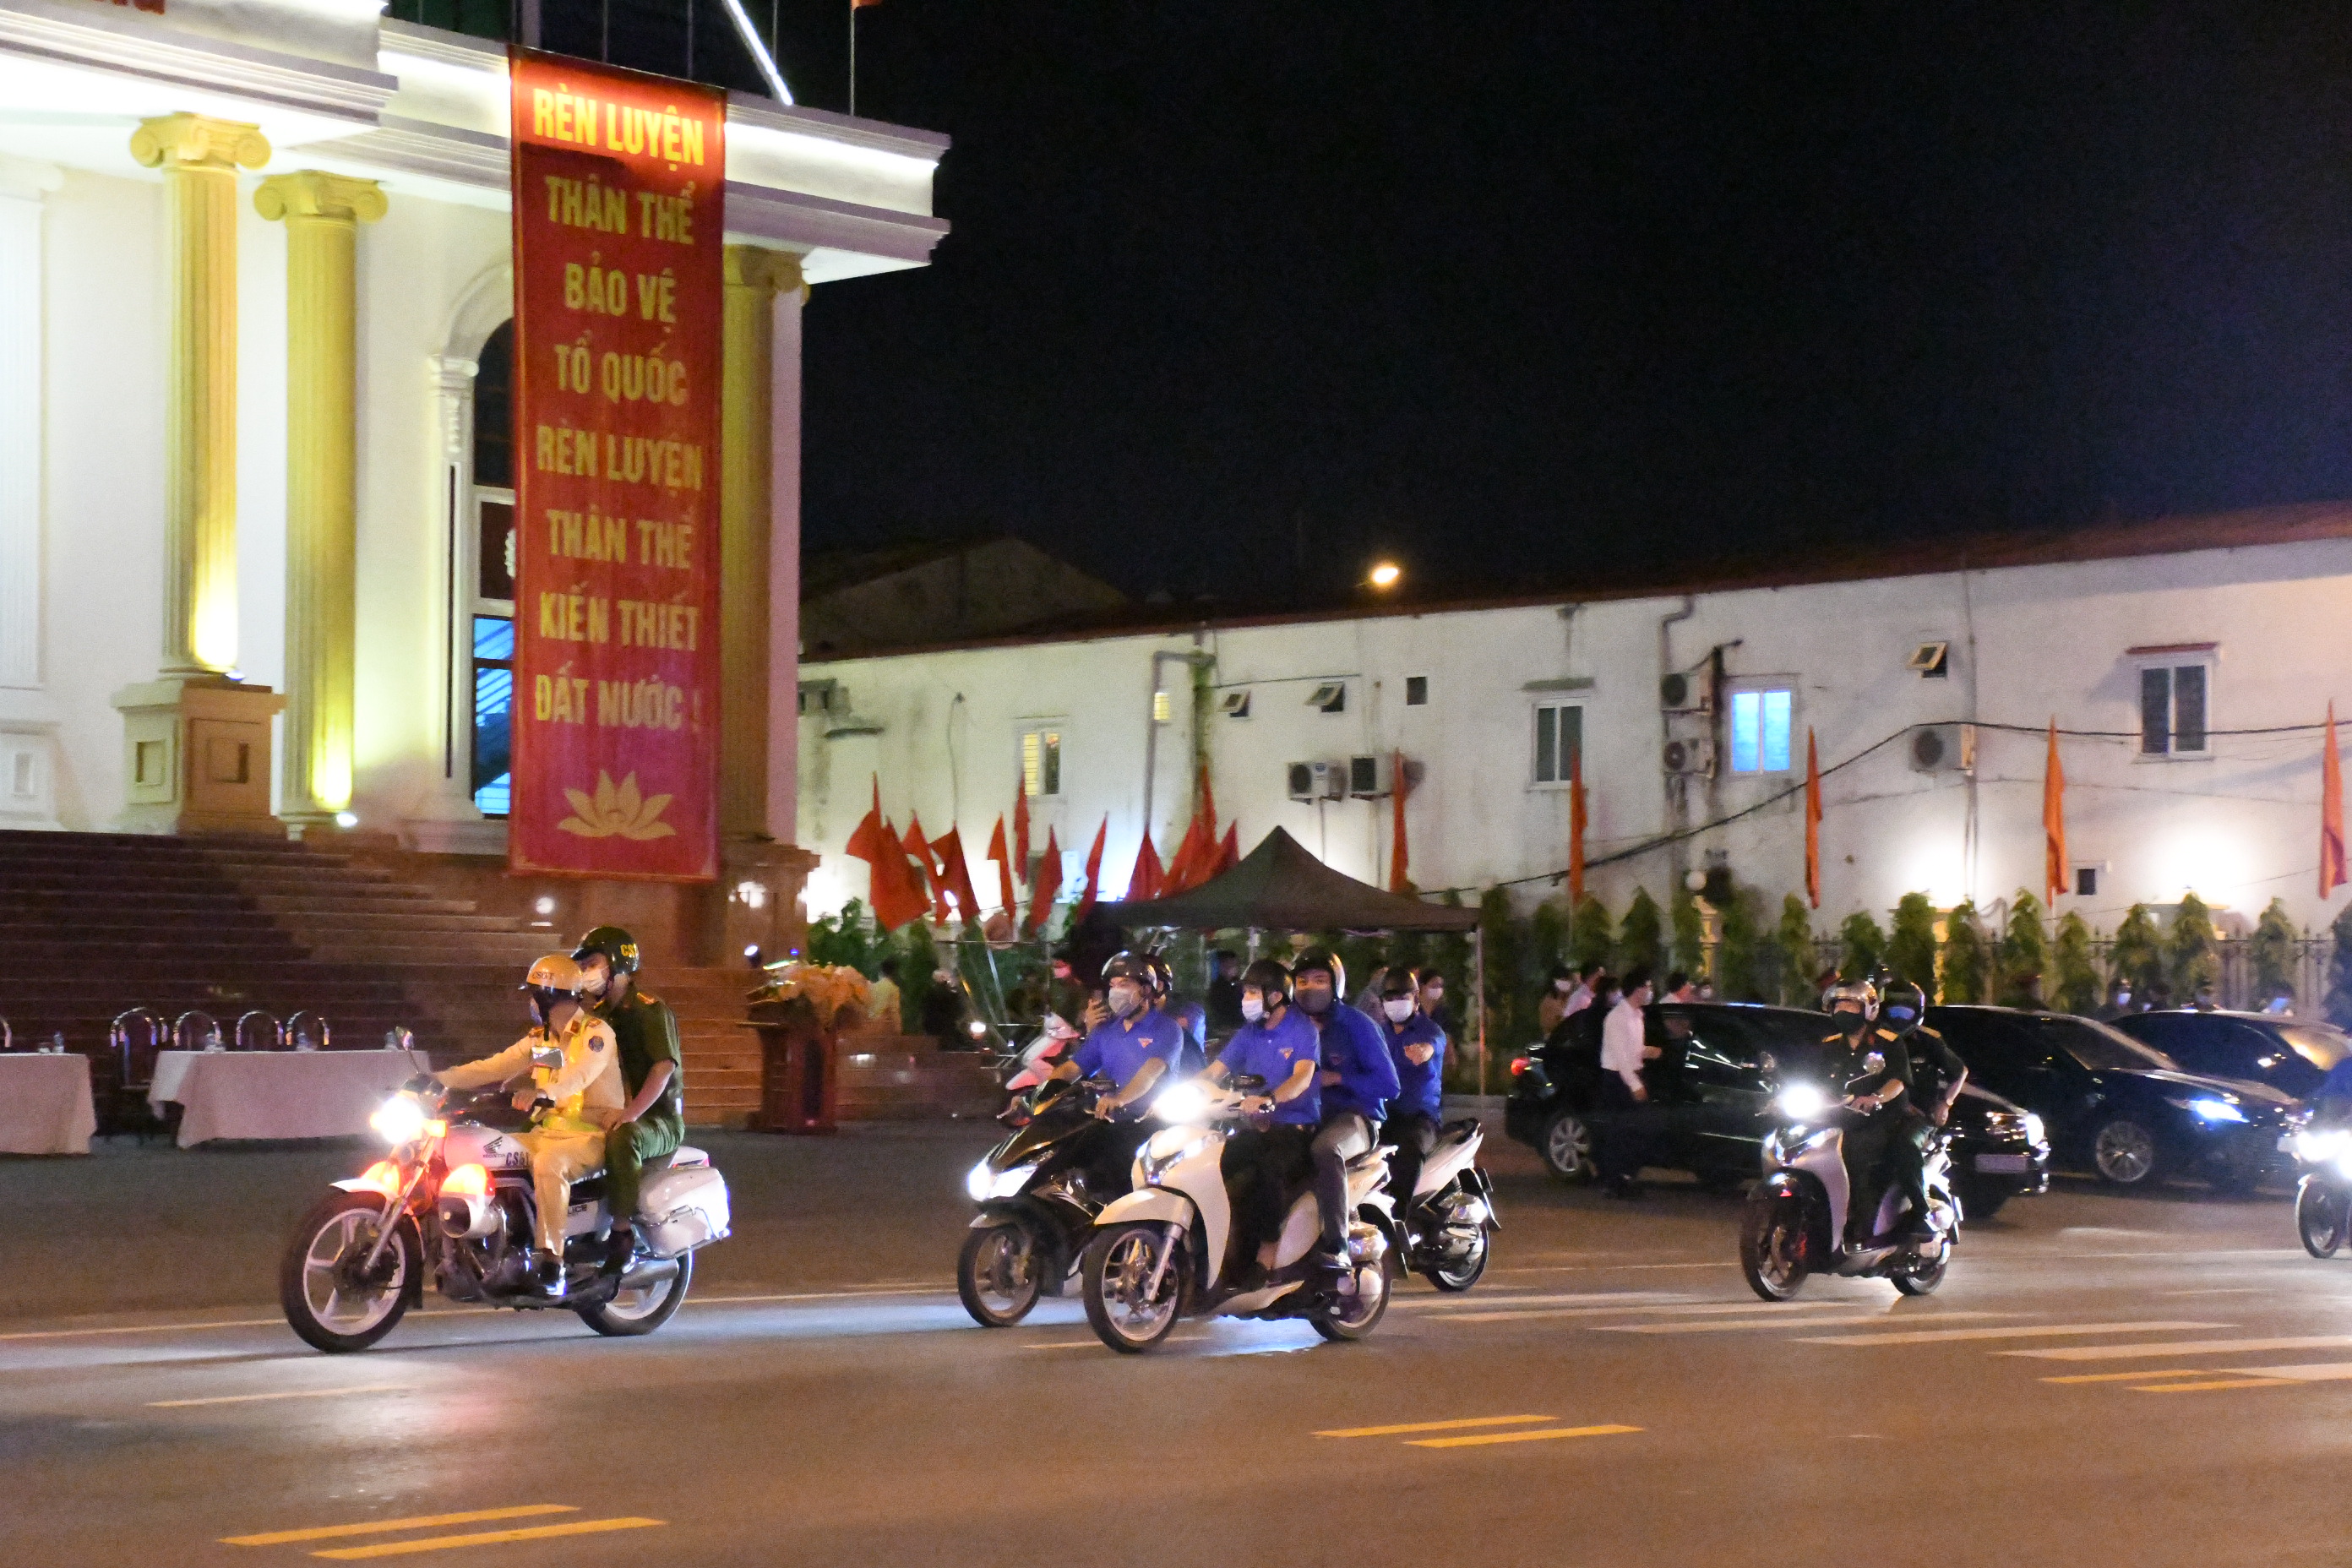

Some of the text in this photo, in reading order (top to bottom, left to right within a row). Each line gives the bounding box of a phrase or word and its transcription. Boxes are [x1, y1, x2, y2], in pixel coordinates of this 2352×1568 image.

[533, 82, 705, 172] RÈN LUYỆN
[545, 173, 695, 245] THÂN THỂ
[564, 251, 677, 334] BẢO VỆ
[554, 329, 688, 406] TỔ QUỐC
[536, 418, 703, 498] RÈN LUYỆN
[546, 504, 627, 564] THÂN
[539, 580, 700, 651] KIẾN THIẾT
[535, 661, 590, 725] ĐẤT
